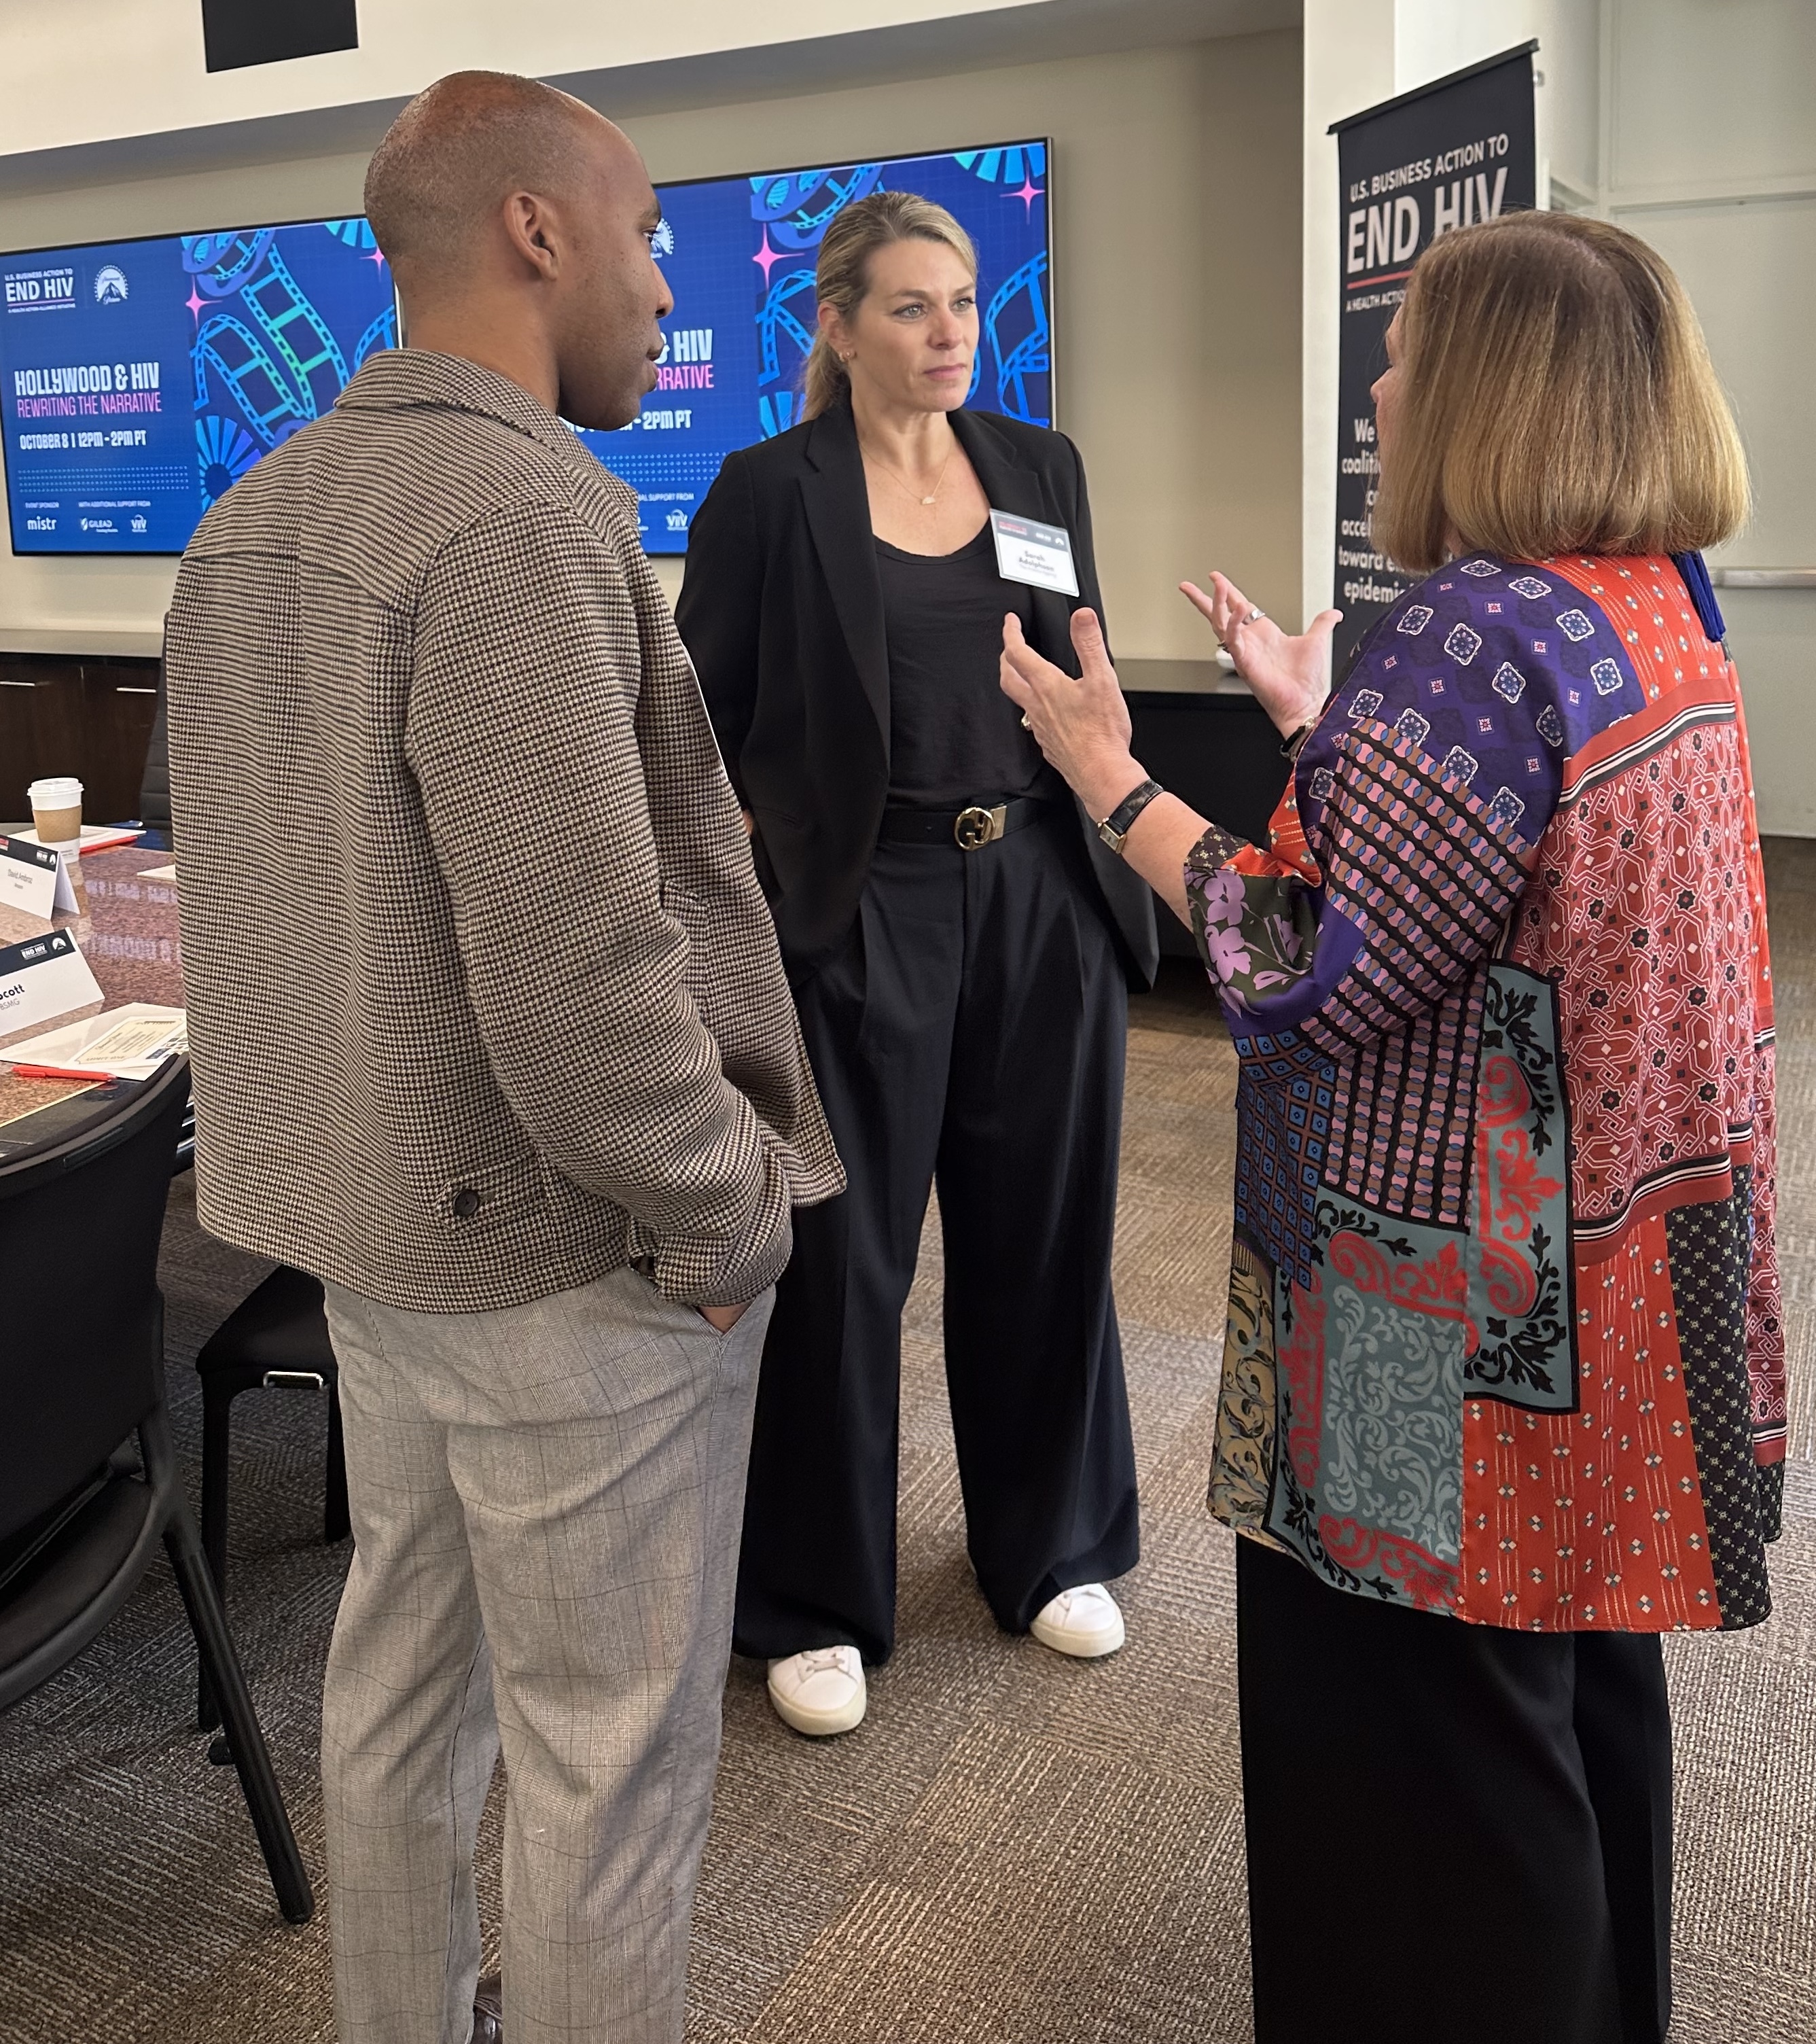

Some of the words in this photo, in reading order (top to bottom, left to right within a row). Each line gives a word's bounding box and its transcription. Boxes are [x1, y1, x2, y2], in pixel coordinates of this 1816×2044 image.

[1350, 180, 1370, 202] U.S.
[1371, 158, 1431, 196] BUSINESS
[1434, 140, 1484, 176] ACTION
[1487, 133, 1509, 158] TO
[1347, 195, 1420, 274] END
[1434, 166, 1508, 239] HIV
[5, 280, 40, 302] END
[43, 277, 73, 298] HIV
[1381, 289, 1406, 306] ACTIO
[673, 329, 713, 362] HIV
[14, 365, 112, 396] HOLLYWOOD
[115, 364, 128, 391] &
[130, 362, 160, 389] HIV
[656, 364, 715, 391] RRATIVE
[17, 396, 76, 418] REWRITING
[77, 395, 99, 415] THE
[101, 392, 162, 414] NARRATIVE
[642, 410, 674, 430] 2PM
[675, 410, 692, 429] PT
[1354, 418, 1375, 443] We
[20, 433, 61, 450] OCTOBER
[61, 432, 69, 448] 8
[110, 430, 133, 446] 2PM
[134, 429, 147, 446] PT
[1341, 449, 1381, 474] coaliti
[27, 515, 57, 531] mistr
[88, 520, 112, 528] GILEAD
[1341, 513, 1371, 537] accel
